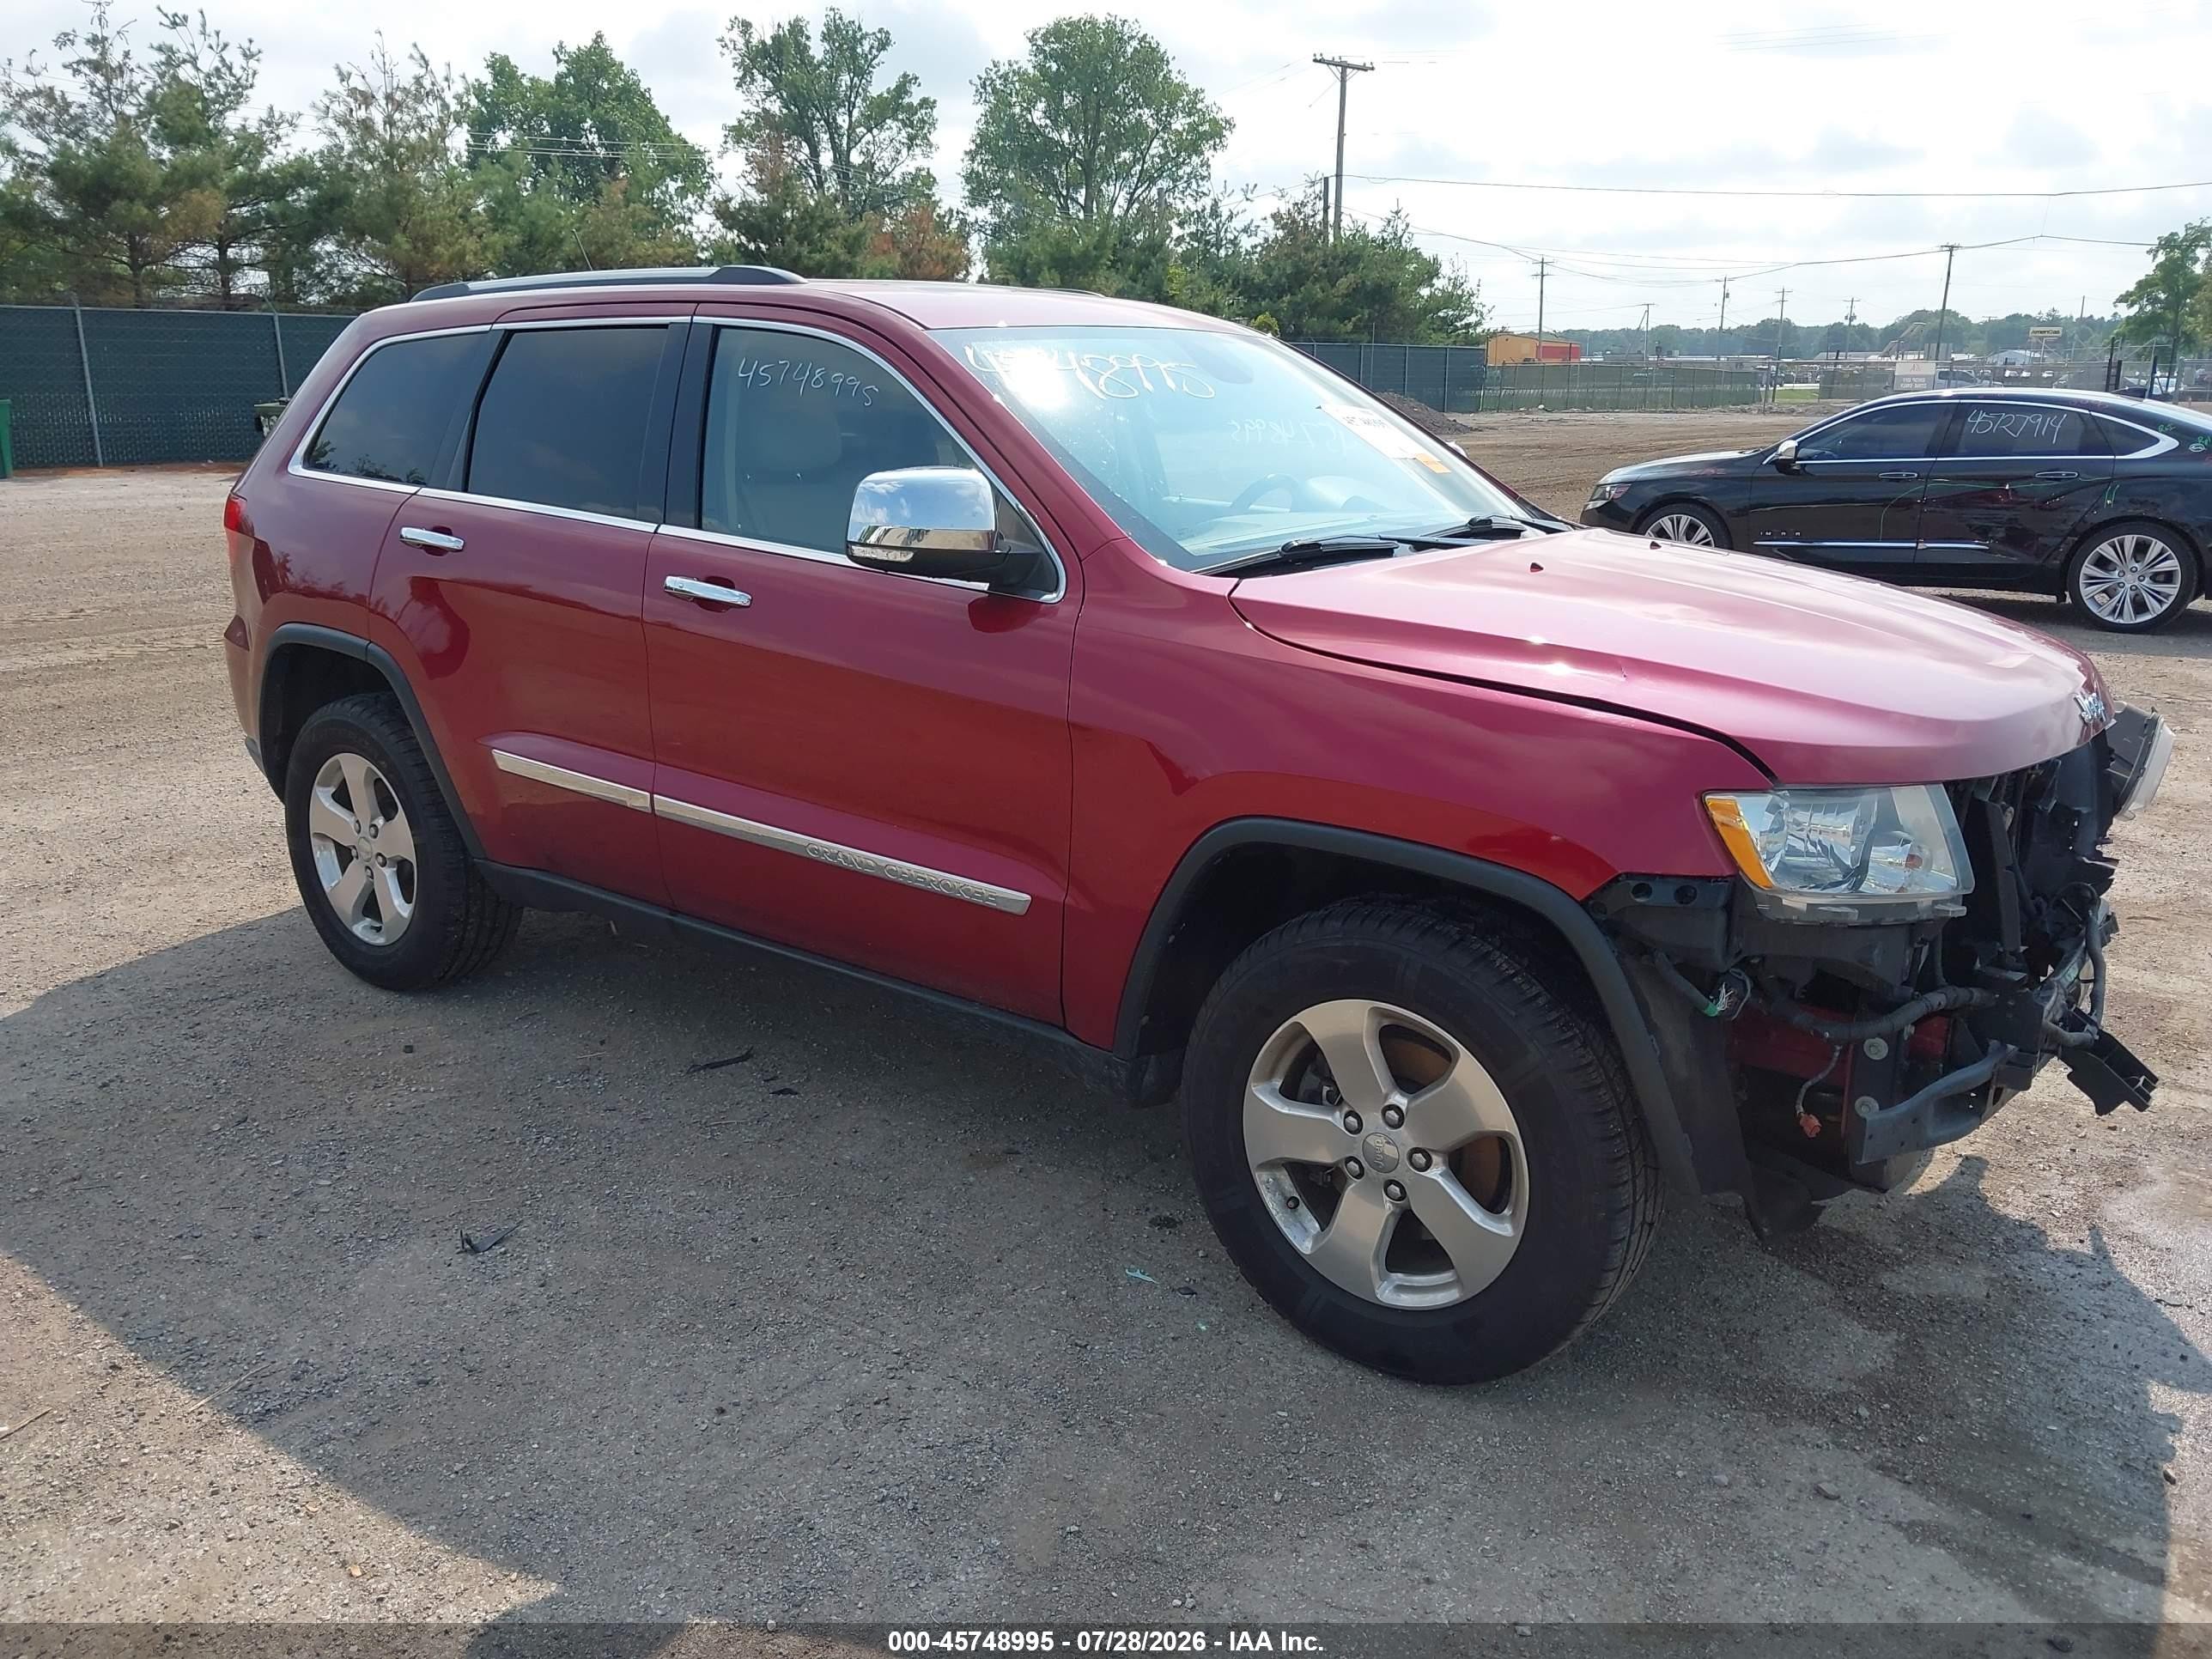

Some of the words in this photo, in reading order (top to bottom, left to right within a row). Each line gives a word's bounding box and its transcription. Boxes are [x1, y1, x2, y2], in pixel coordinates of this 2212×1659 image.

[738, 356, 879, 406] 45748995
[963, 345, 1215, 400] 448995
[805, 842, 878, 872] GRAND
[883, 864, 998, 906] CHEROKEE
